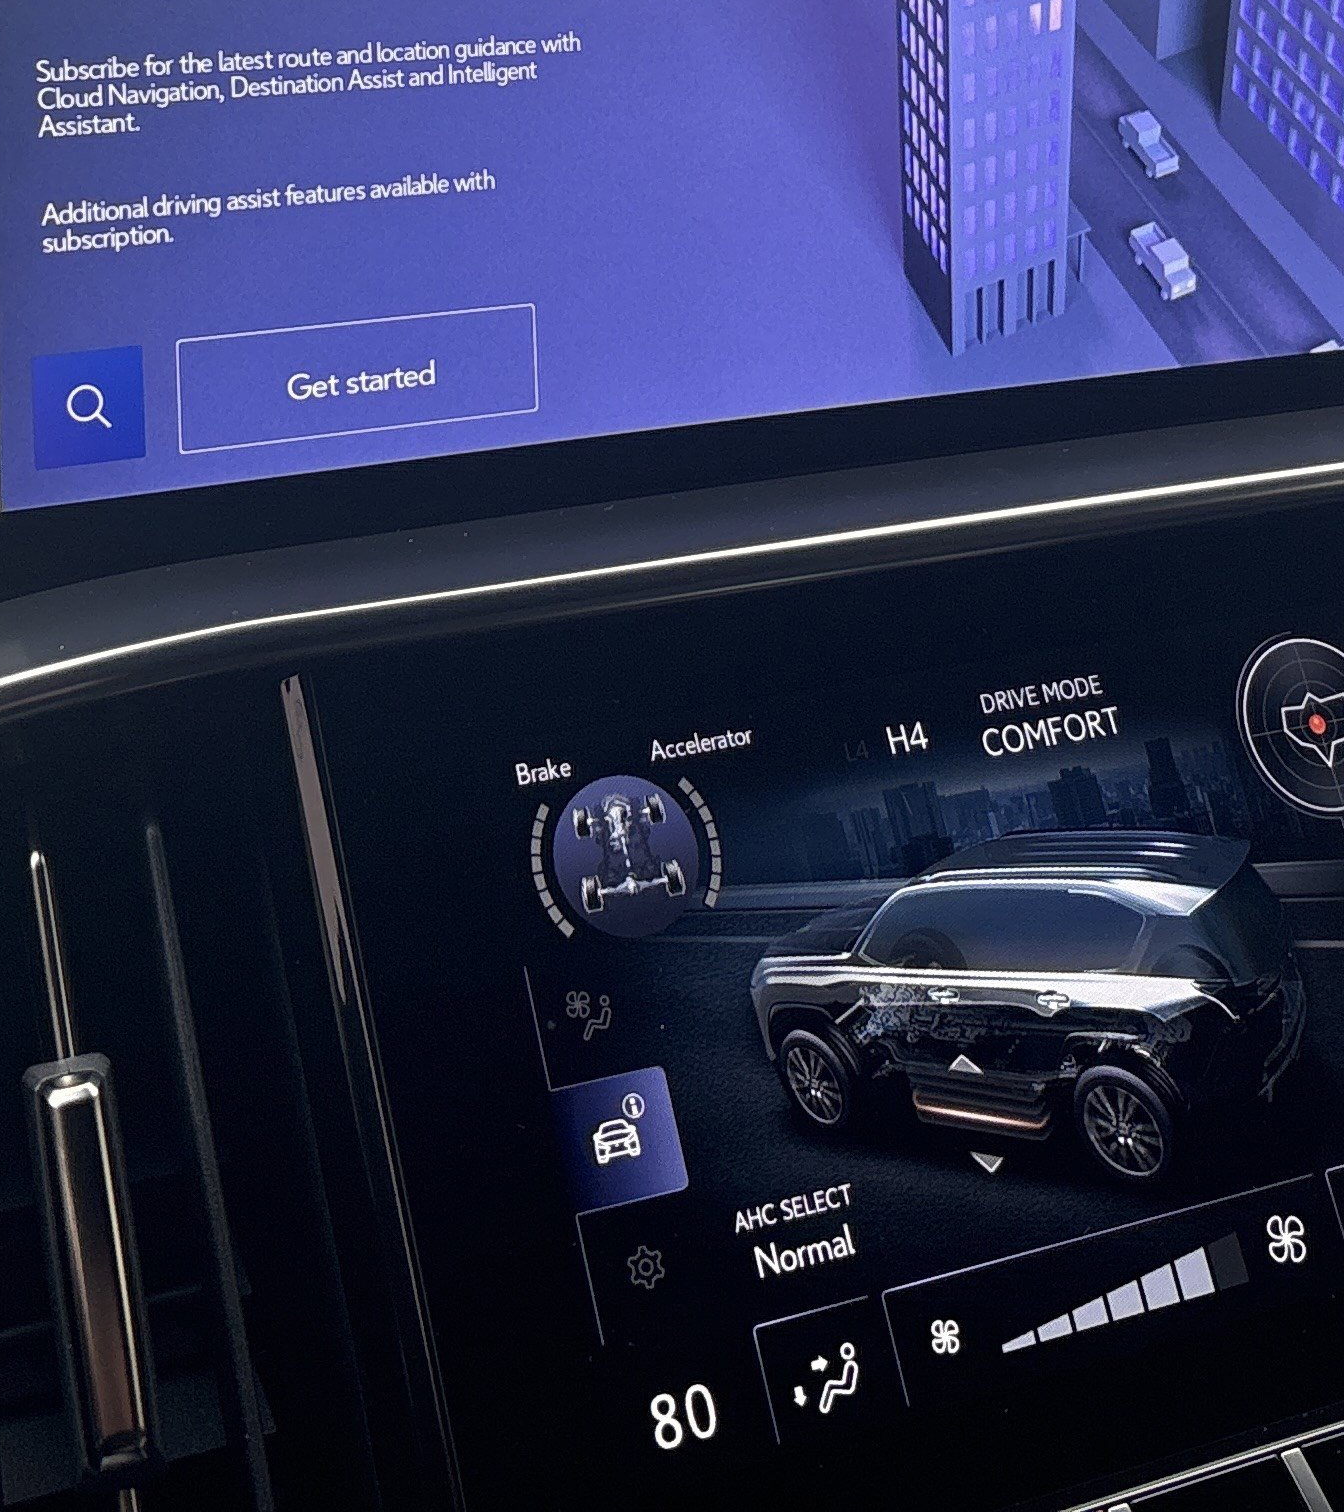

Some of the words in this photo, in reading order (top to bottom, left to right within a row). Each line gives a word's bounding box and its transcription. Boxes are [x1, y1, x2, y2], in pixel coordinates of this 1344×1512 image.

[36, 58, 140, 82] Subscribe
[145, 54, 172, 77] for
[180, 52, 212, 74] the
[218, 49, 273, 71] latest
[278, 46, 332, 67] route
[337, 43, 372, 64] and
[377, 37, 450, 62] location
[454, 35, 536, 61] guidance
[541, 31, 581, 54] with
[38, 85, 103, 110] Cloud
[108, 79, 225, 108] Navigation,
[231, 73, 344, 98] Destination
[347, 68, 404, 91] Assist
[409, 65, 443, 87] and
[448, 61, 537, 87] Intelligent
[38, 113, 140, 138] Assistant.
[42, 197, 148, 226] Additional
[153, 190, 222, 220] driving
[227, 187, 280, 211] assist
[285, 183, 365, 207] features
[370, 174, 449, 200] available
[453, 169, 495, 192] with
[42, 225, 174, 254] subscription.
[287, 374, 339, 401] Get
[346, 360, 436, 395] started
[979, 686, 1040, 715] DRIVE
[1042, 674, 1103, 704] MODE
[650, 726, 752, 762] Accelerator
[886, 721, 929, 756] H4
[981, 706, 1120, 757] COMFORT
[515, 759, 572, 786] Brake
[735, 1203, 777, 1234] AHC
[780, 1183, 852, 1222] SELECT
[754, 1224, 855, 1278] Normal
[650, 1384, 717, 1450] 80
